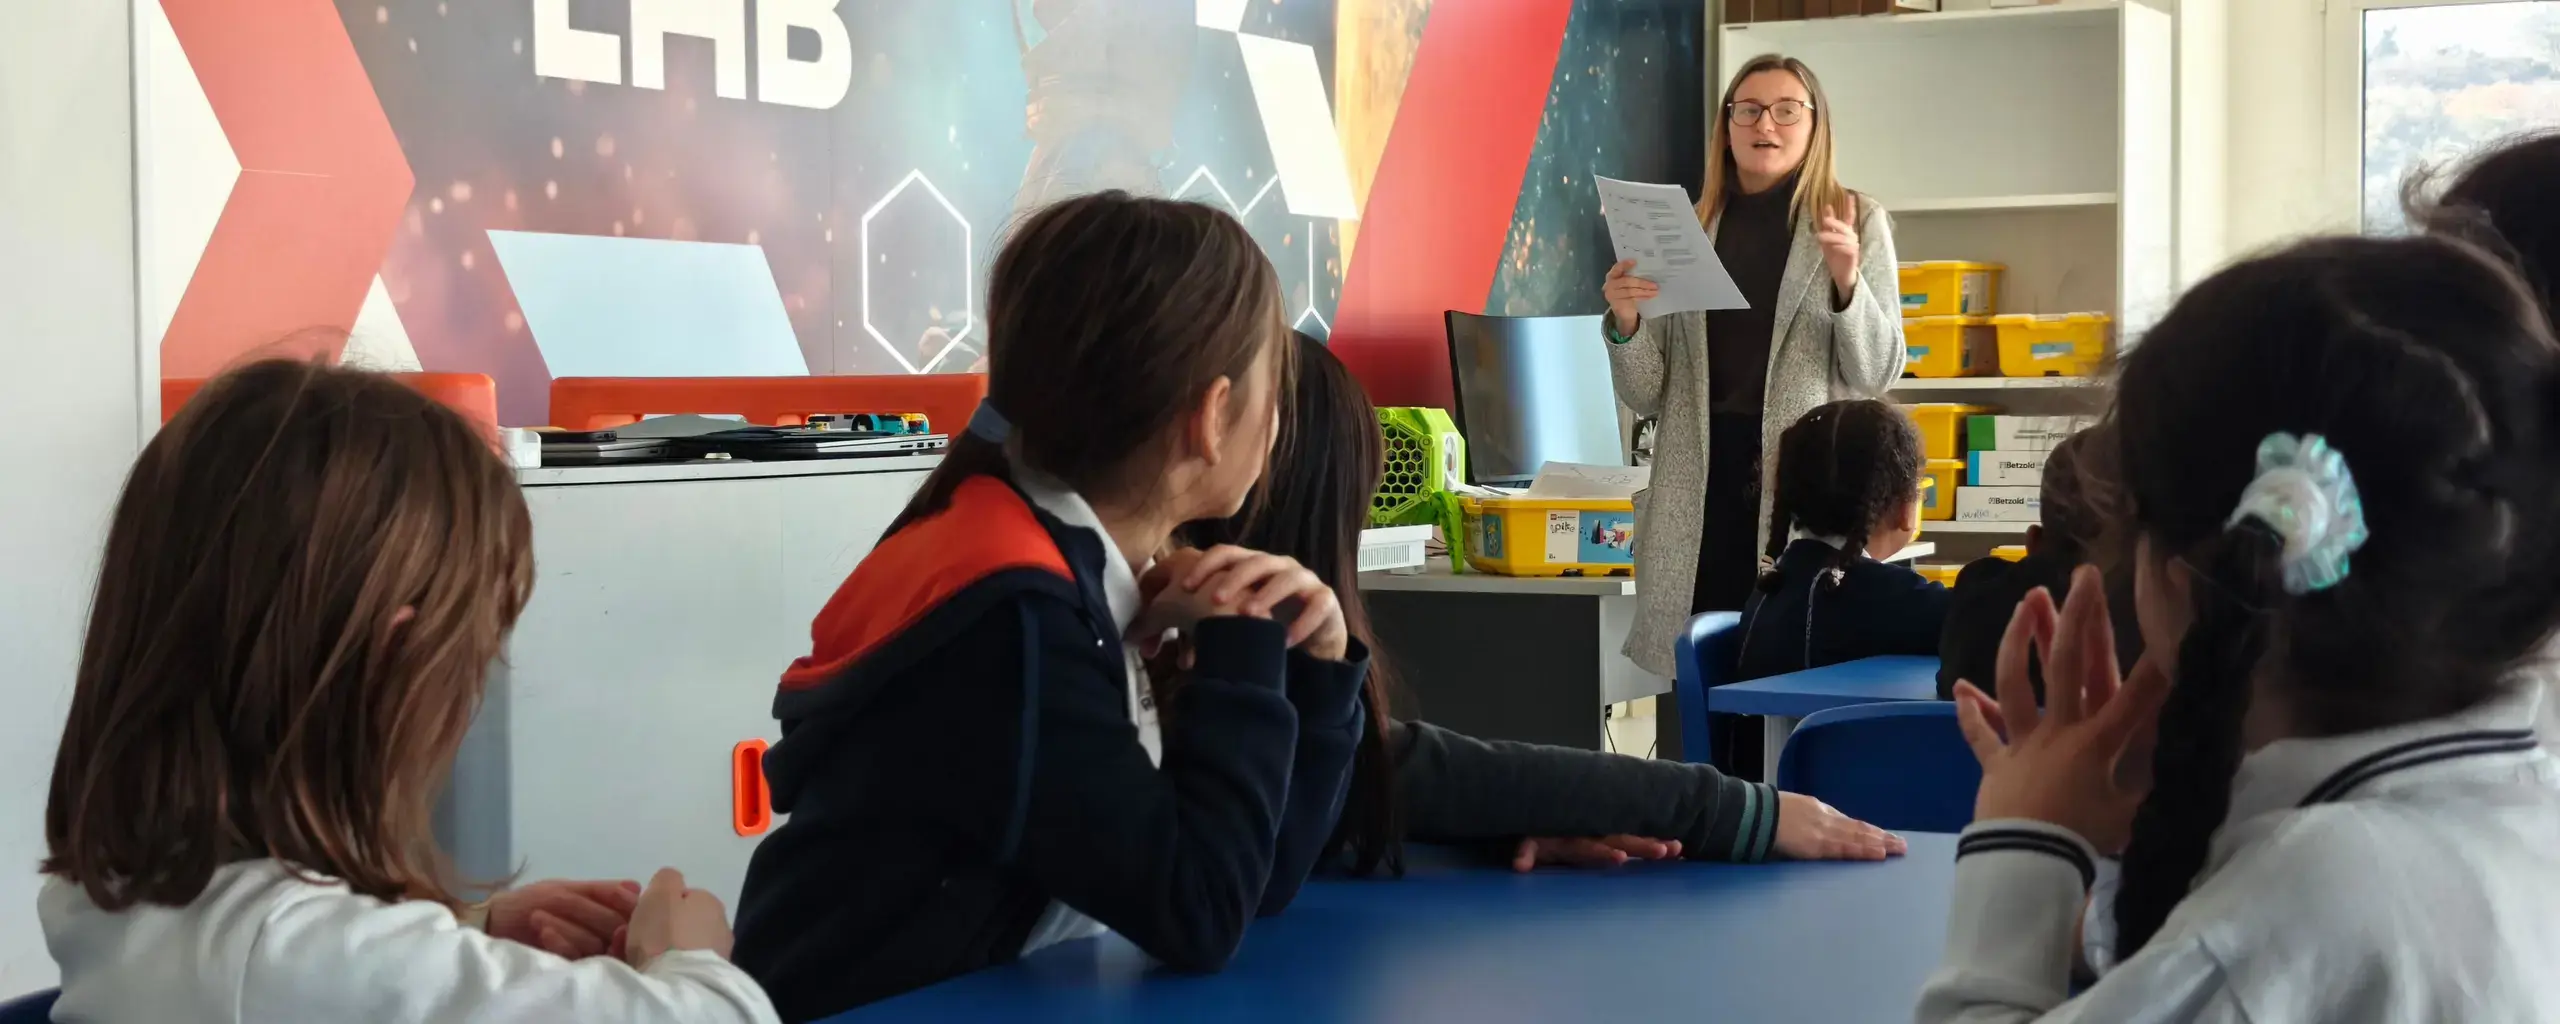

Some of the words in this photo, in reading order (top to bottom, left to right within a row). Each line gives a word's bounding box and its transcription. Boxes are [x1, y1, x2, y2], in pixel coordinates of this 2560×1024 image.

[533, 0, 852, 109] LAB
[2006, 461, 2035, 469] Betzold
[1995, 497, 2025, 505] Betzold
